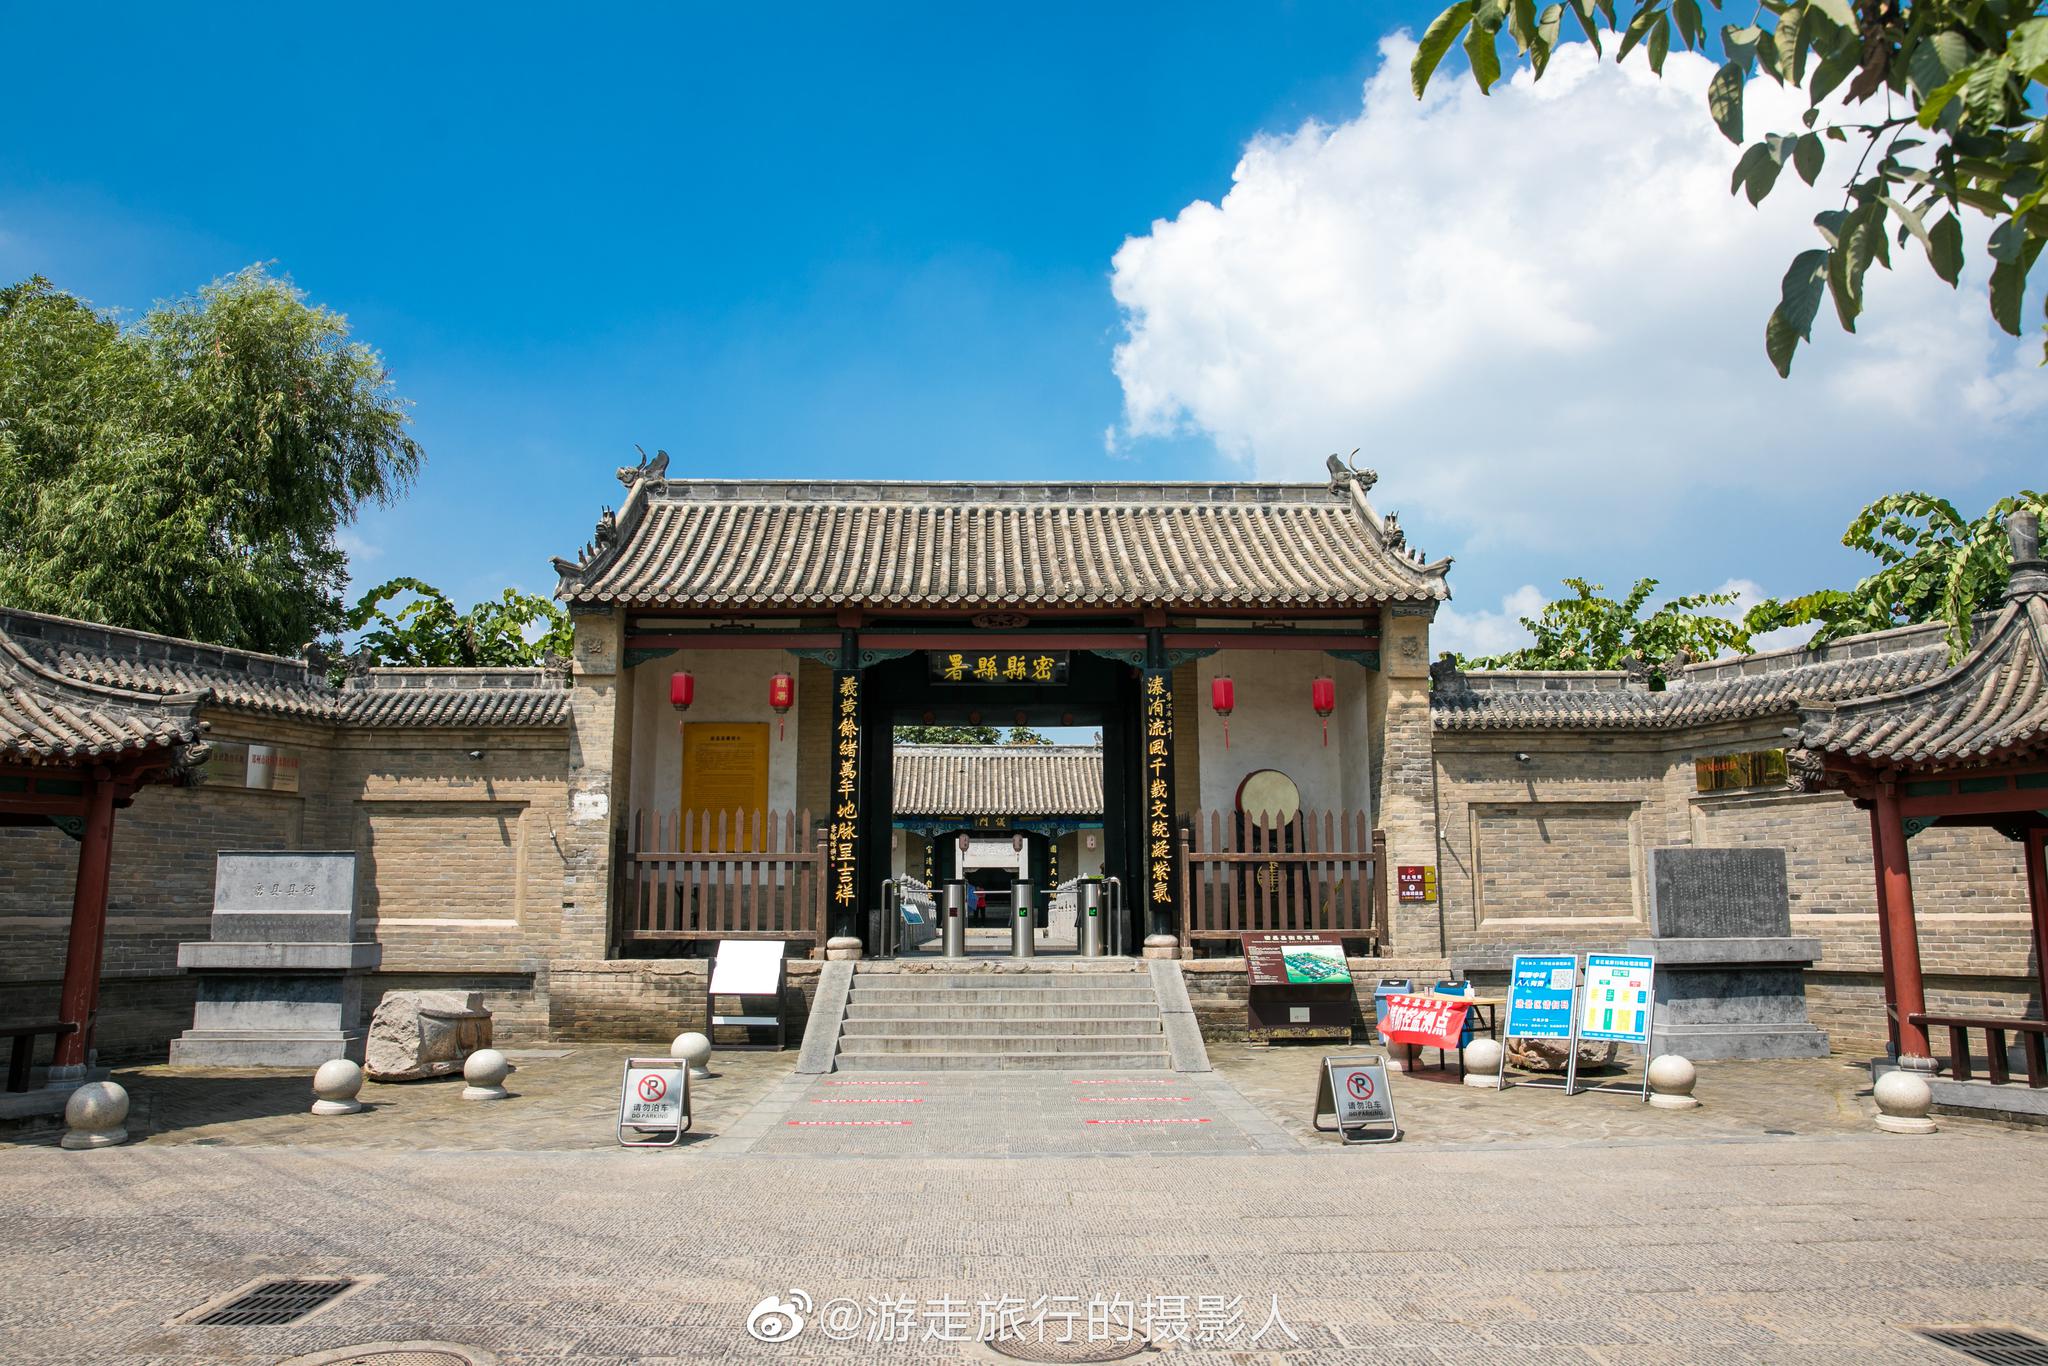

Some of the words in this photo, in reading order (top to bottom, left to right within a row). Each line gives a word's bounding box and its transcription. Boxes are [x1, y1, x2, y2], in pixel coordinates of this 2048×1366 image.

[633, 1104, 669, 1112] 请勿泊车
[1348, 1101, 1381, 1109] 请勿泊车
